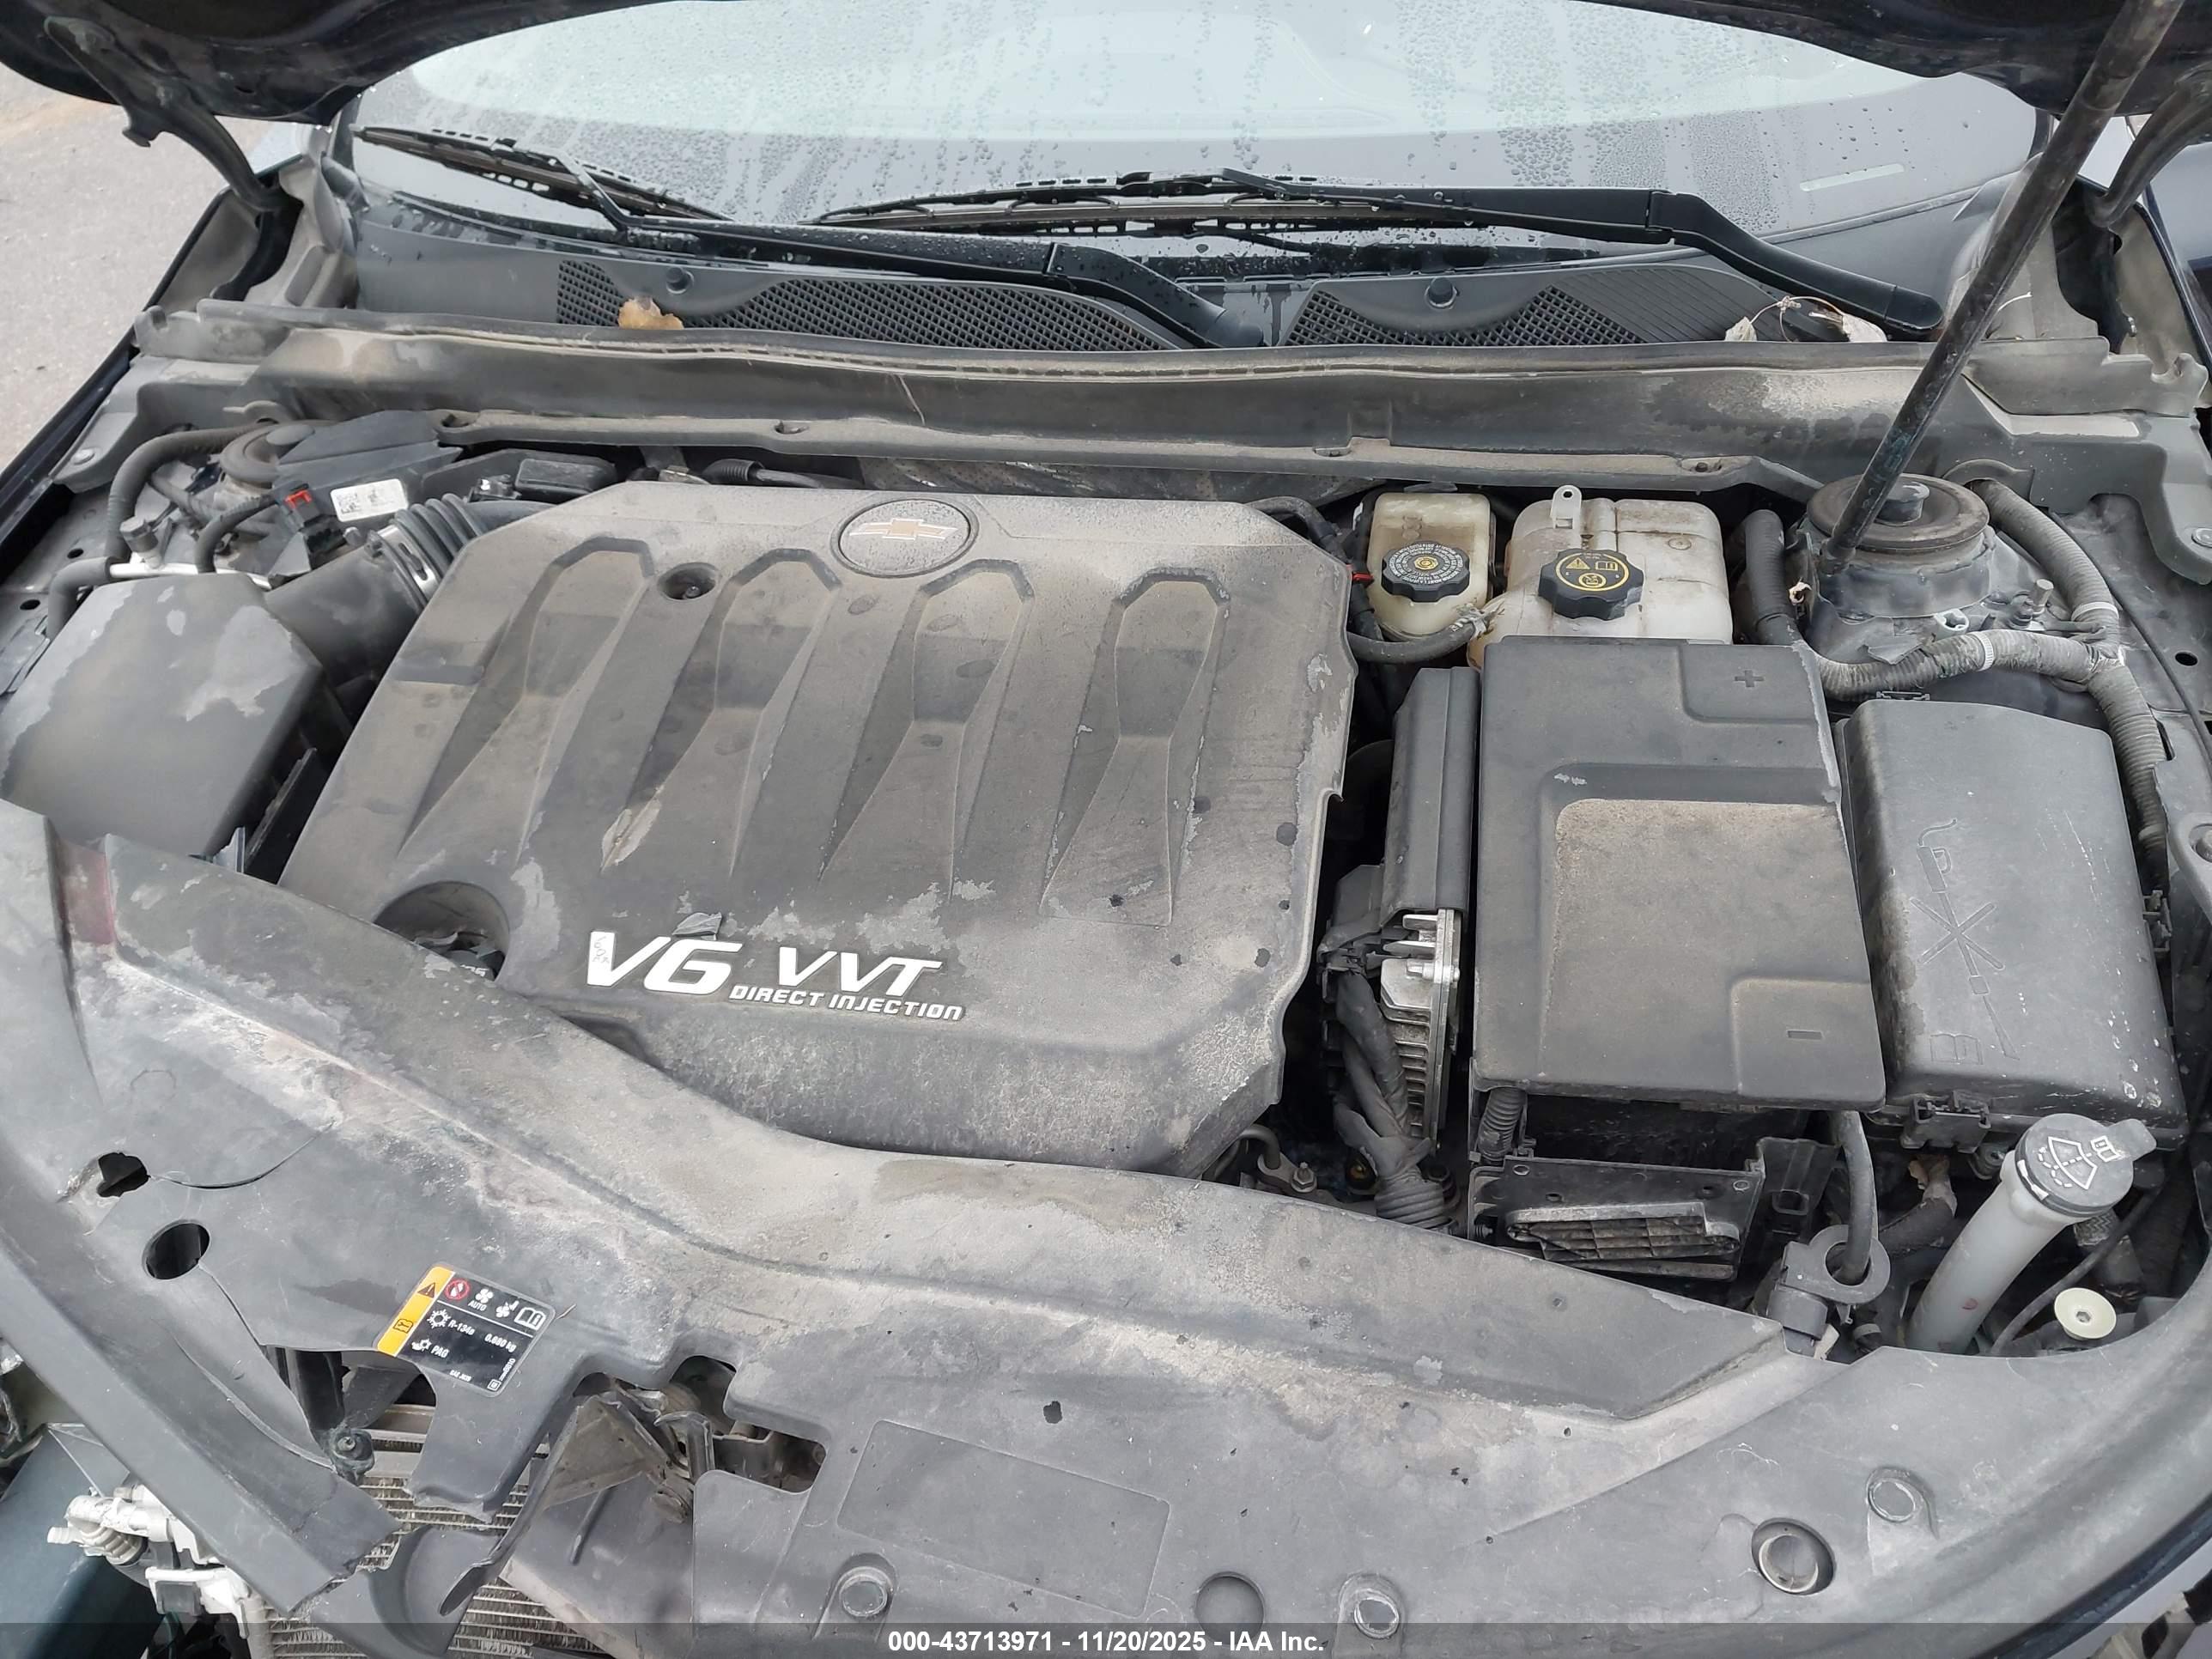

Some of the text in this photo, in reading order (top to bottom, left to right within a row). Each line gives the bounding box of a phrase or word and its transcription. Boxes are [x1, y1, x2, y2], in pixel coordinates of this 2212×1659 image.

[586, 931, 743, 994] V6
[779, 946, 943, 997] VVT
[728, 984, 964, 1020] DIRECT INJECTION
[468, 1299, 488, 1312] AUTO
[431, 1345, 450, 1358] PAG
[447, 1319, 476, 1336] R-134a
[506, 1341, 518, 1353] kg
